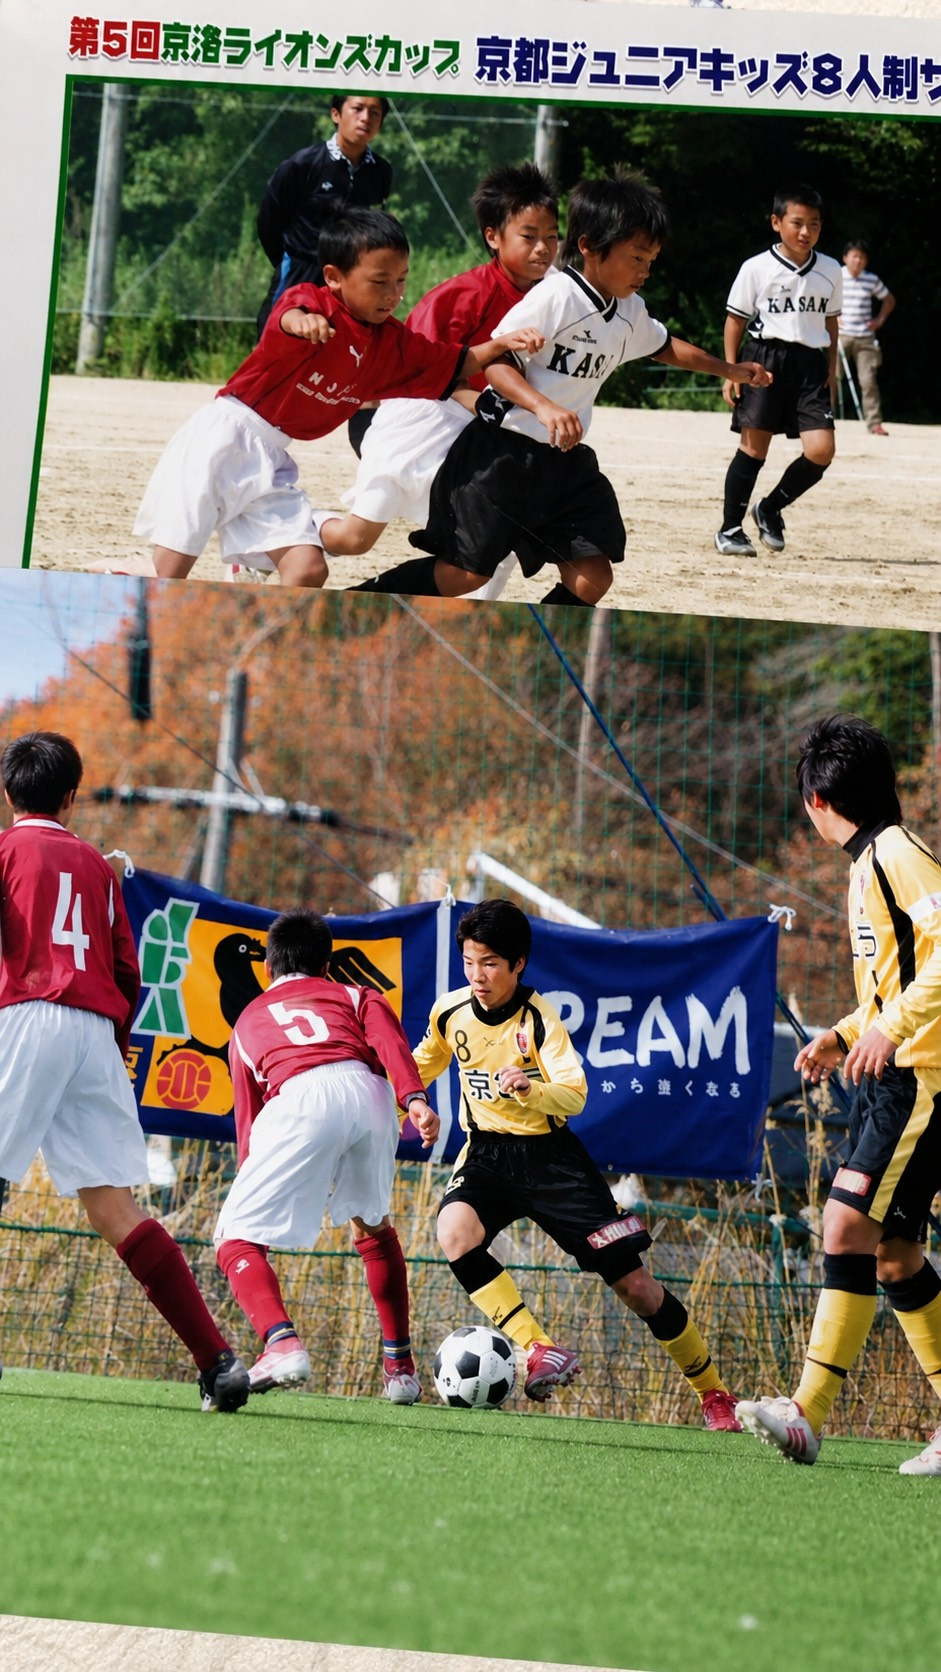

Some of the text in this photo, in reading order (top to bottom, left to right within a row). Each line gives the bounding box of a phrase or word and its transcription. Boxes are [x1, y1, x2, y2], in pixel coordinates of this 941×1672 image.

[68, 16, 461, 76] 第5回京洛ライオンズカップ
[768, 296, 829, 314] KASAN
[51, 872, 90, 972] 4
[267, 1001, 331, 1046] 5
[454, 1029, 472, 1063] 8
